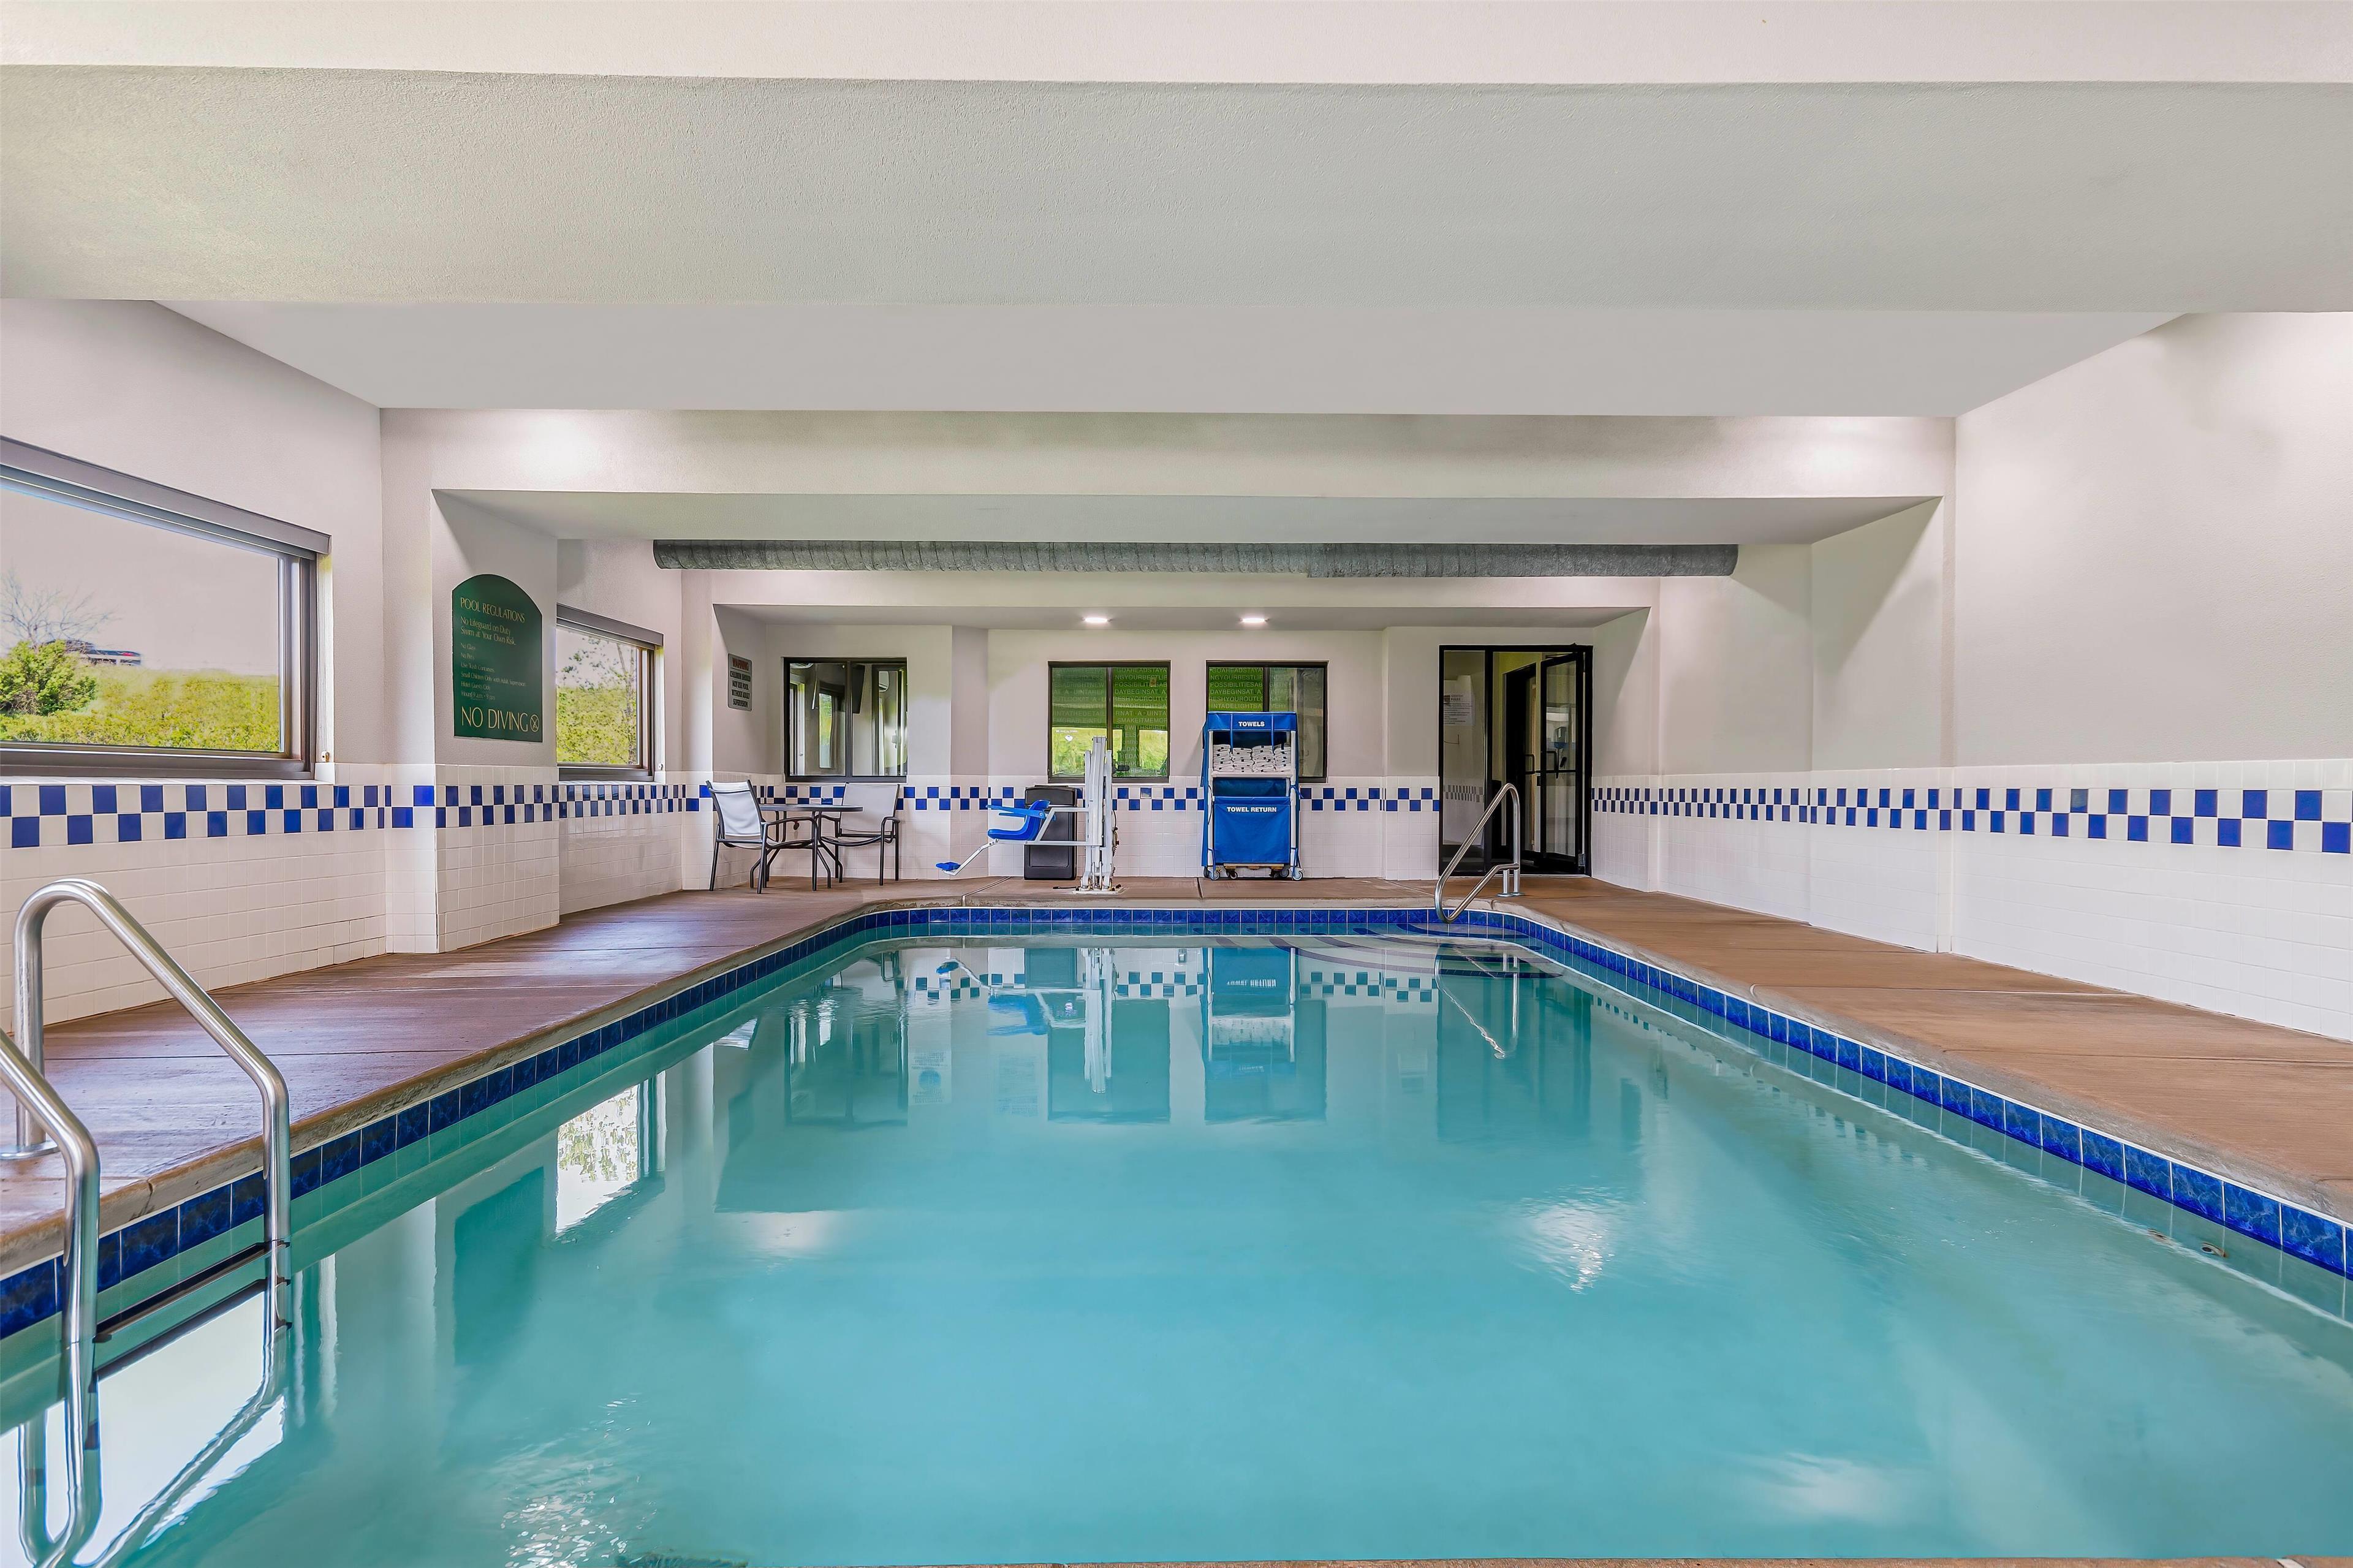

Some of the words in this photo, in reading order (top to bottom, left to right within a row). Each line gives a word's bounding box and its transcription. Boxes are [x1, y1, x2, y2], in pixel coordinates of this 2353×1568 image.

[460, 597, 480, 612] POOL
[483, 603, 525, 623] REGULATIONS
[461, 616, 469, 625] No
[470, 618, 491, 631] Lifeguard
[500, 624, 510, 635] Duty
[461, 627, 474, 637] Swim
[482, 631, 492, 640] Your
[494, 634, 506, 643] Own
[461, 706, 483, 727] NO
[488, 709, 528, 732] DIVING
